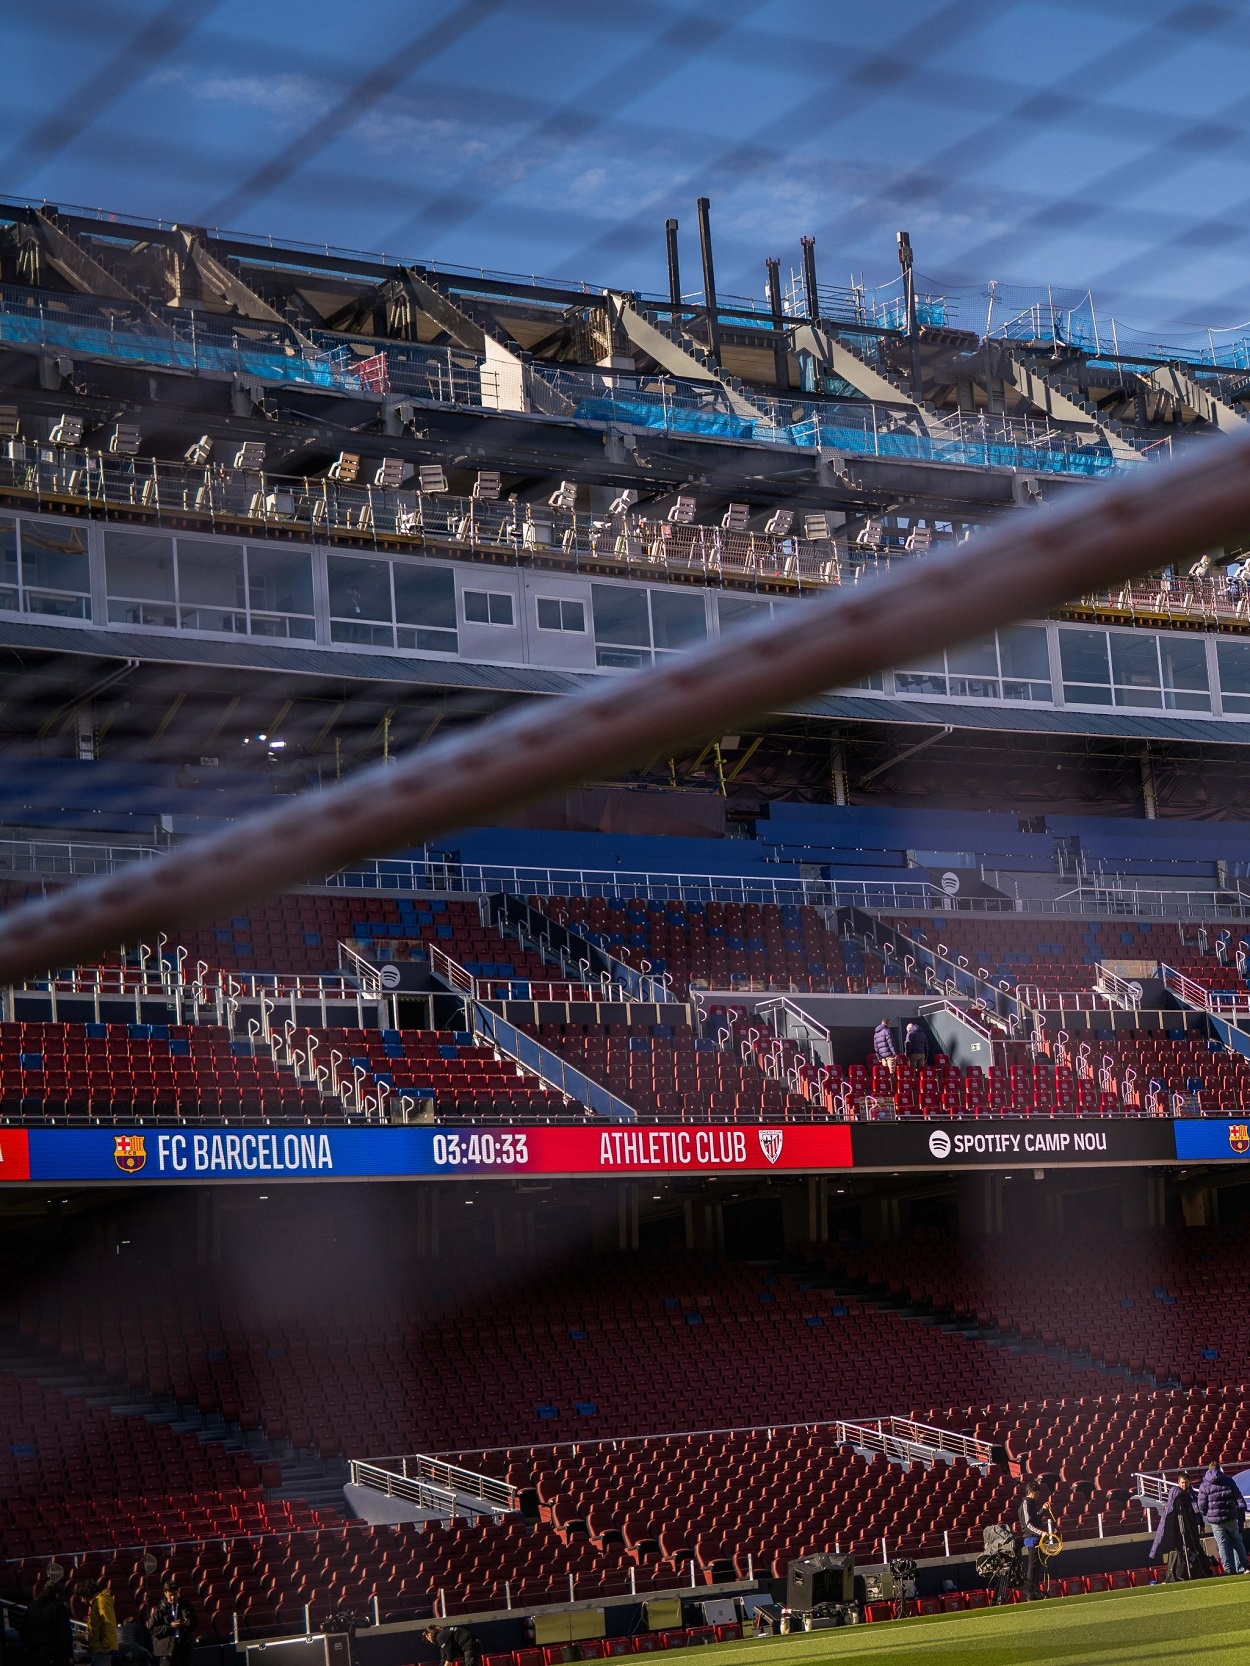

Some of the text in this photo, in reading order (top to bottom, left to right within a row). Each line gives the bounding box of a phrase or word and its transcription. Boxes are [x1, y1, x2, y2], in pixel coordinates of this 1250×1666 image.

[158, 1134, 333, 1171] FC BARCELONA
[433, 1134, 528, 1165] 03:40:33
[600, 1131, 747, 1164] ATHLETIC CLUB
[953, 1132, 1107, 1153] SPOTIFY CAMP NOU
